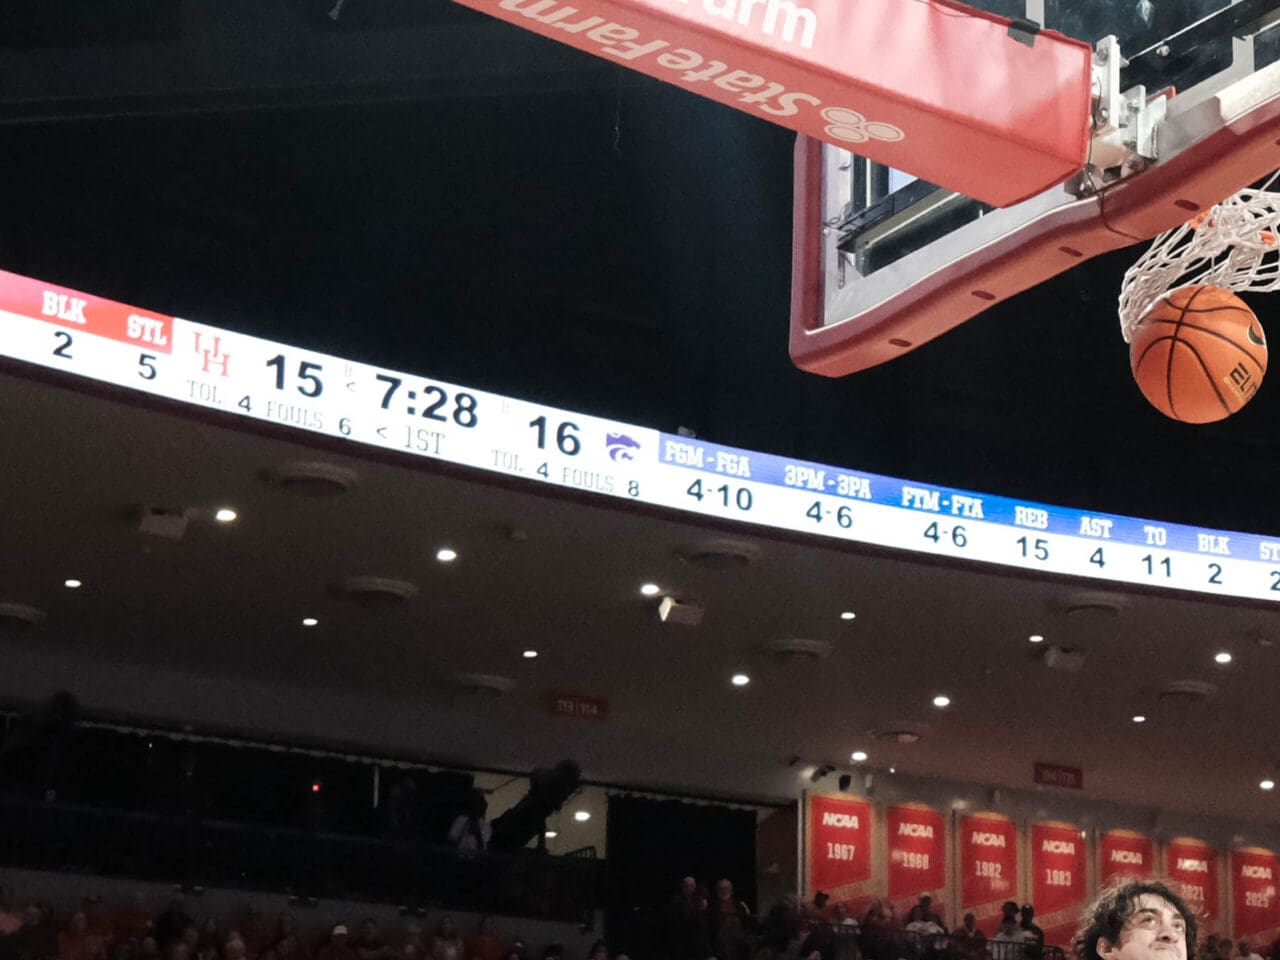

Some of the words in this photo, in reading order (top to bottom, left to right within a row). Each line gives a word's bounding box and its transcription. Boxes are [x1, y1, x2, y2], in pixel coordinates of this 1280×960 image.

[684, 0, 817, 48] arm
[42, 290, 87, 324] BLK
[126, 314, 167, 346] STL
[52, 331, 74, 359] 2
[138, 353, 158, 380] 5
[265, 353, 324, 399] 15
[237, 395, 252, 412] 4
[338, 416, 352, 437] 6
[376, 373, 478, 428] 7:28
[403, 425, 446, 456] 1ST
[529, 415, 582, 456] 16
[536, 462, 550, 479] 4
[628, 480, 641, 498] 8
[1015, 505, 1049, 530] REB
[1079, 516, 1113, 539] AST
[1144, 525, 1167, 546] TO
[1197, 533, 1232, 555] BLK
[1016, 536, 1049, 561] 15
[1089, 547, 1105, 568] 4
[1142, 554, 1172, 578] 11
[1208, 563, 1223, 585] 2
[822, 812, 859, 829] NCAA
[898, 822, 934, 838] NCAA
[972, 831, 1006, 848] NCAA
[827, 842, 855, 862] 1967
[1042, 839, 1075, 855] NCAA
[1111, 849, 1142, 865] NCAA
[1242, 865, 1272, 880] NCAA
